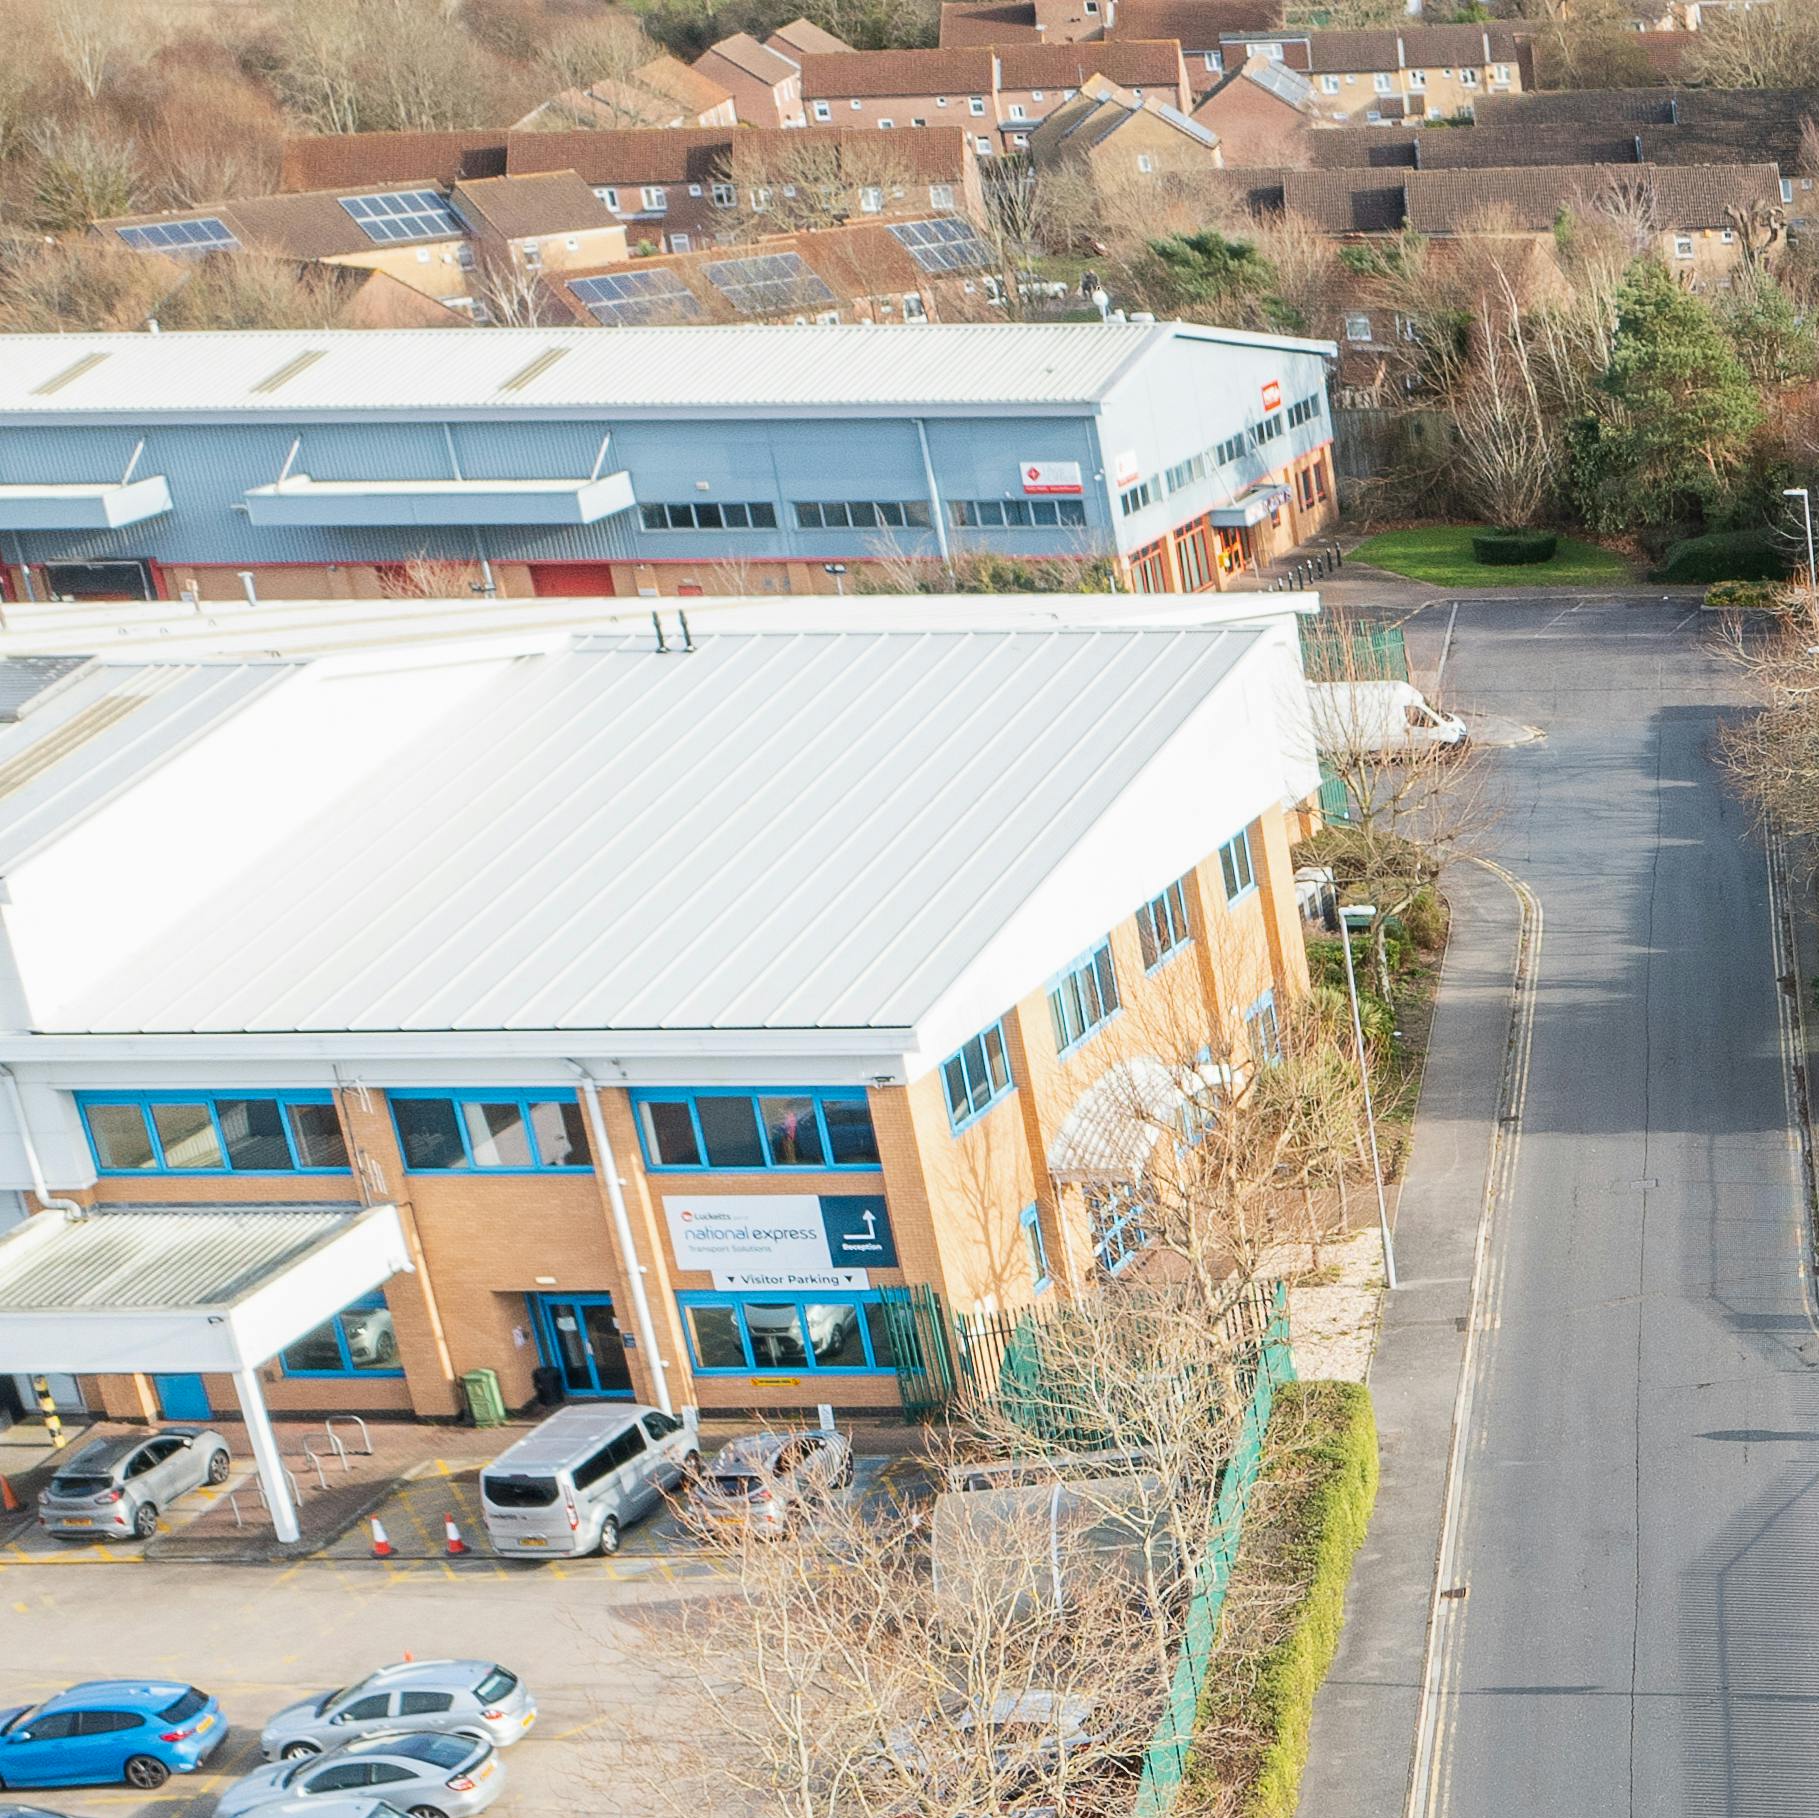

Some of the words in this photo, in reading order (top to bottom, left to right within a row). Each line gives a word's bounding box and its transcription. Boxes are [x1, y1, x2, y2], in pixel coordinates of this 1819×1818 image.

[685, 1225, 749, 1241] national
[752, 1227, 817, 1244] express
[740, 1274, 784, 1285] Visitor
[787, 1274, 840, 1286] Parking
